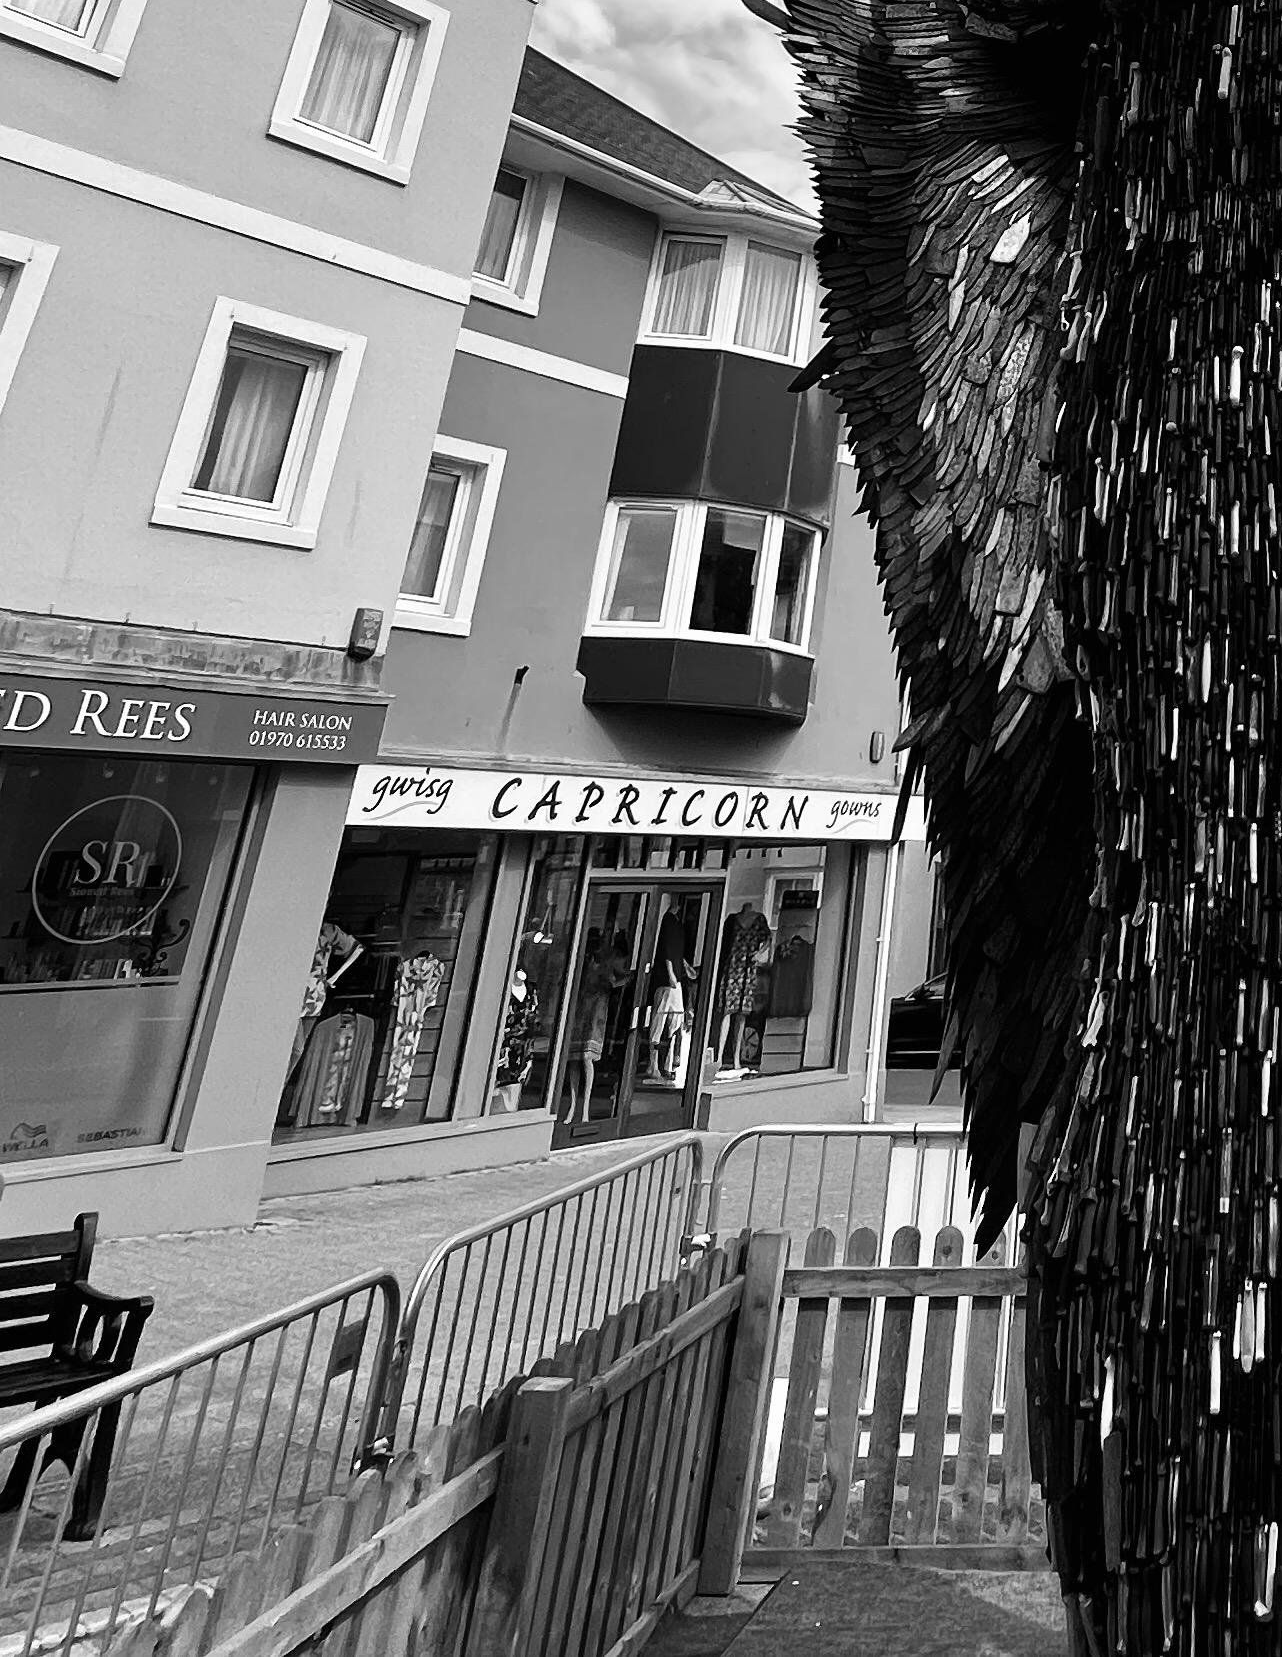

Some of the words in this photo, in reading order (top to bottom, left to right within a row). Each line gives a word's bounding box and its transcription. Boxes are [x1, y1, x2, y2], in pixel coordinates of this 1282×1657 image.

[69, 688, 197, 742] REES
[253, 709, 296, 727] HAIR
[299, 713, 353, 731] SALON
[249, 730, 294, 748] 01970
[296, 734, 347, 751] 615533
[362, 767, 454, 815] gwisg
[491, 777, 809, 830] CAPRICORN
[825, 799, 883, 829] gowns
[73, 840, 141, 885] SR
